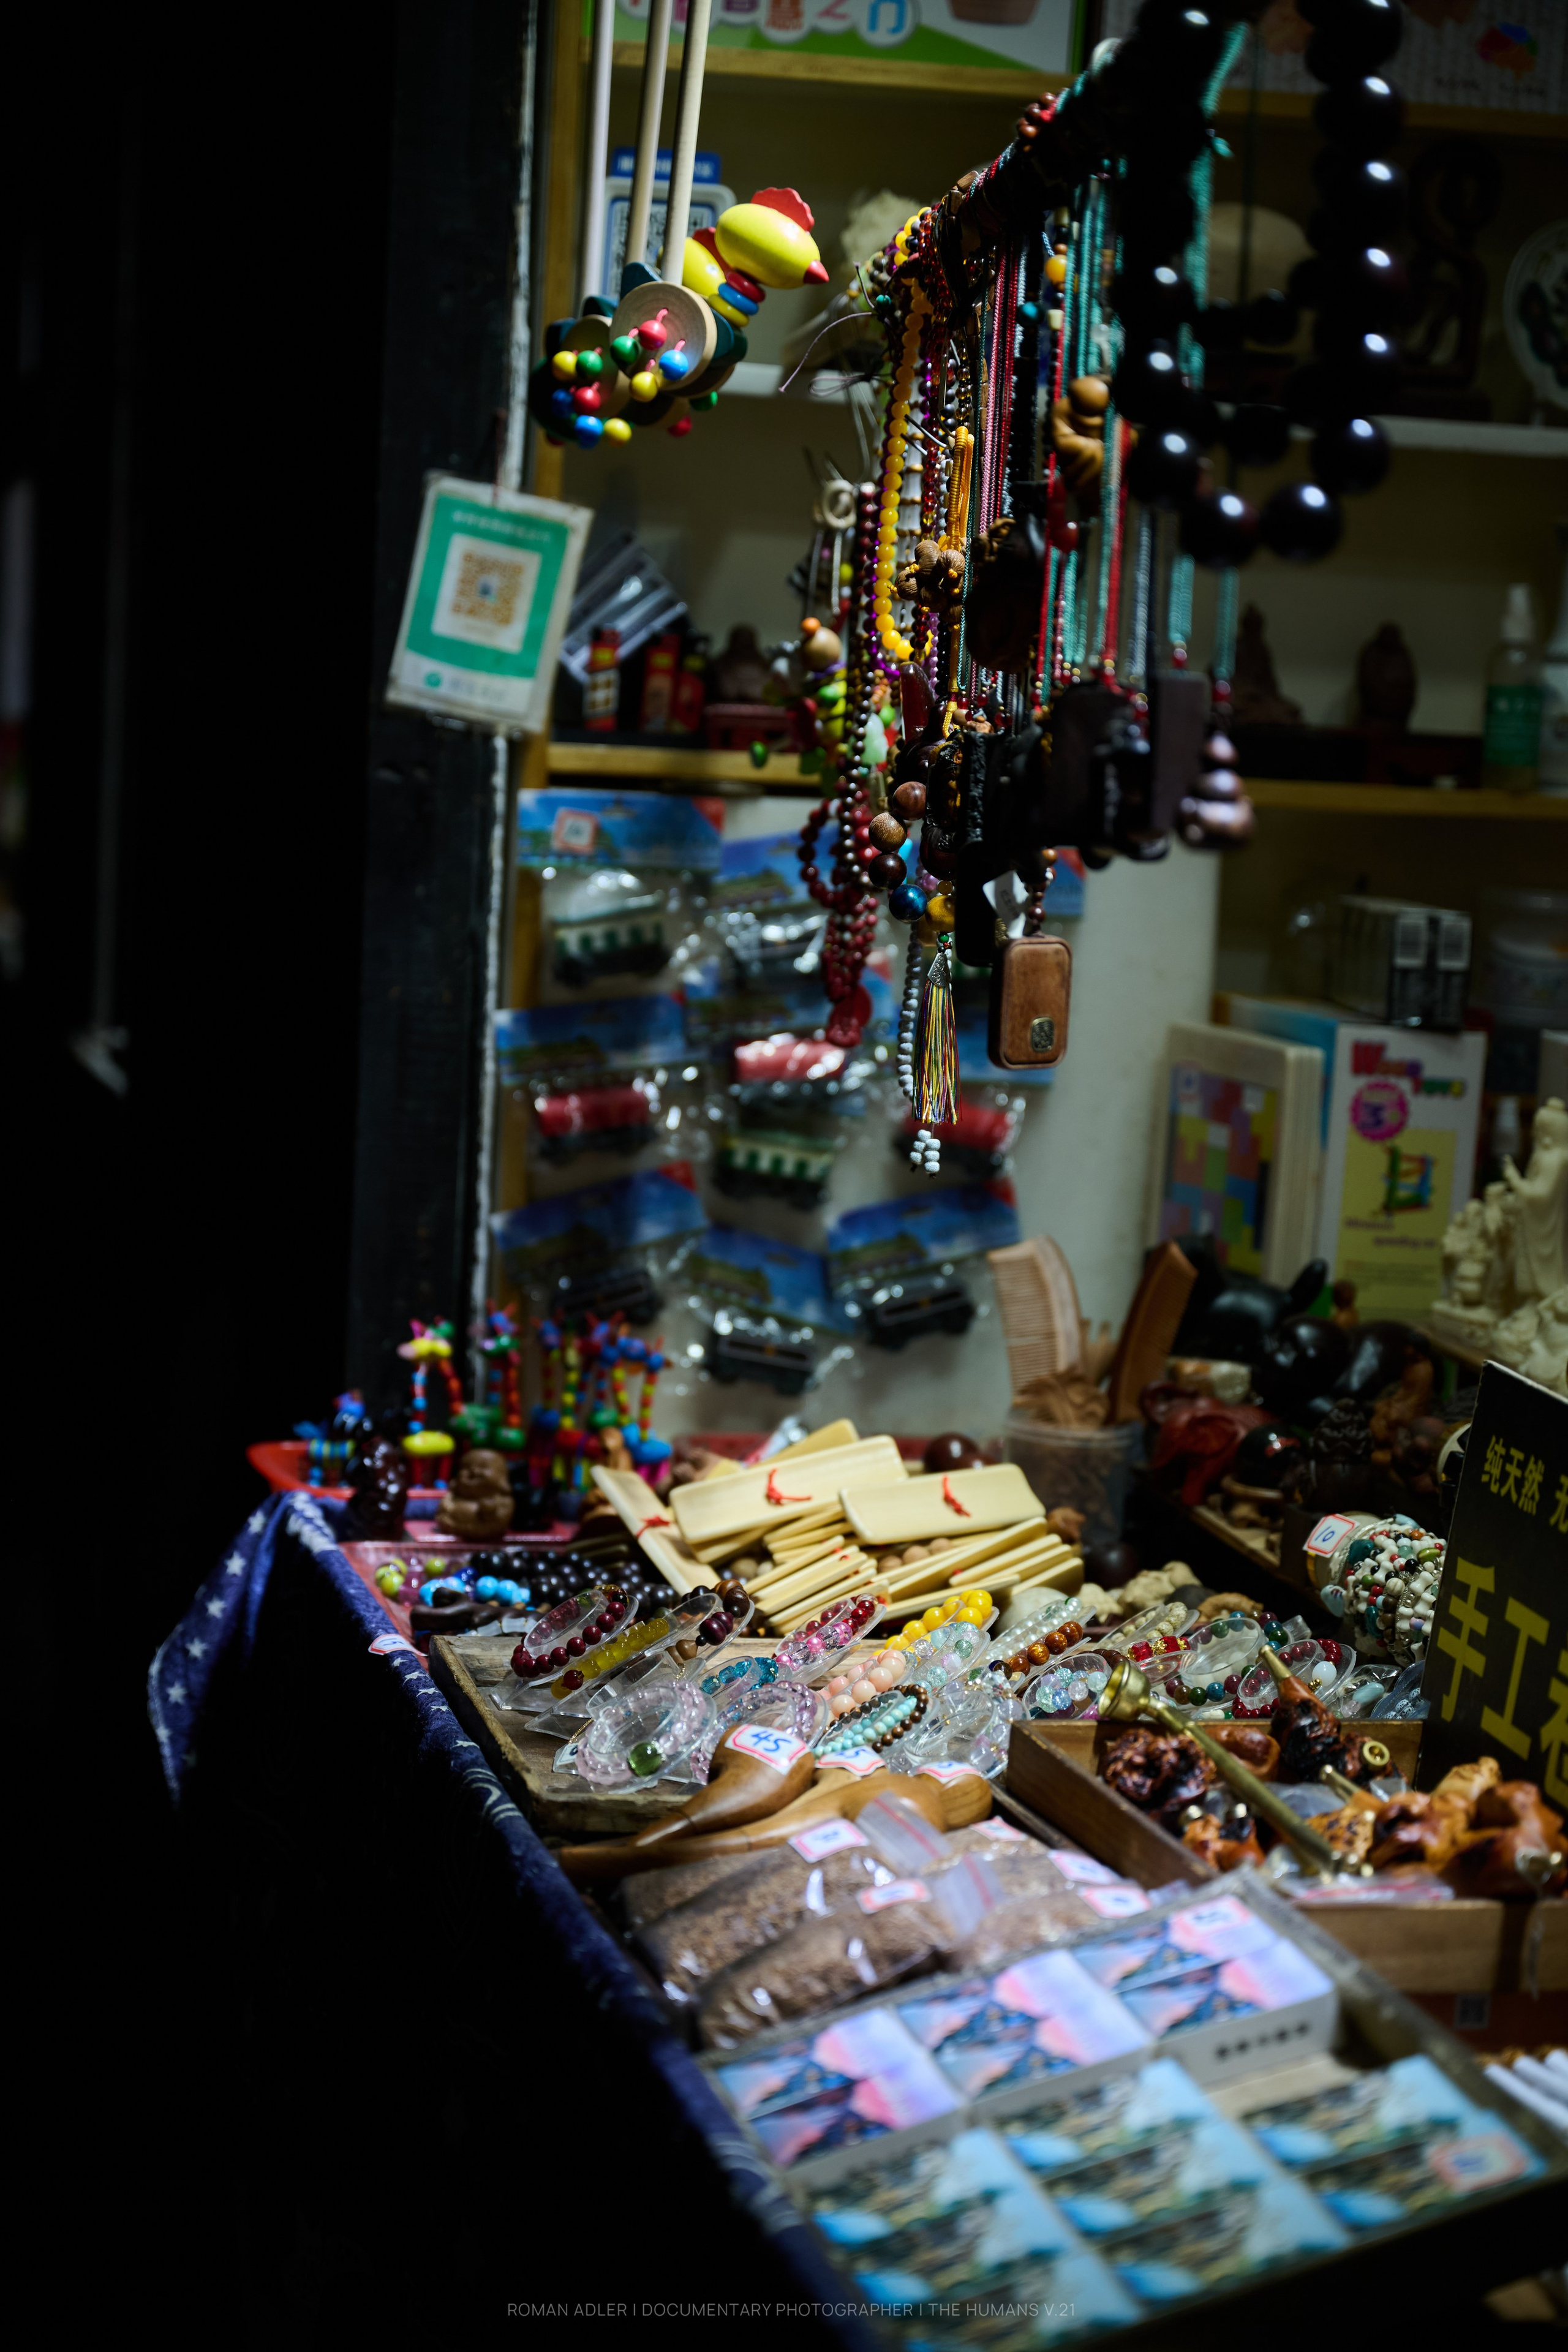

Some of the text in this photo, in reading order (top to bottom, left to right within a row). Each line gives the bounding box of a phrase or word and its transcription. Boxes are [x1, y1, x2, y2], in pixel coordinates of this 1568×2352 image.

[1480, 1434, 1545, 1517] 纯天然
[1314, 1526, 1335, 1542] 10
[751, 1730, 793, 1752] 45
